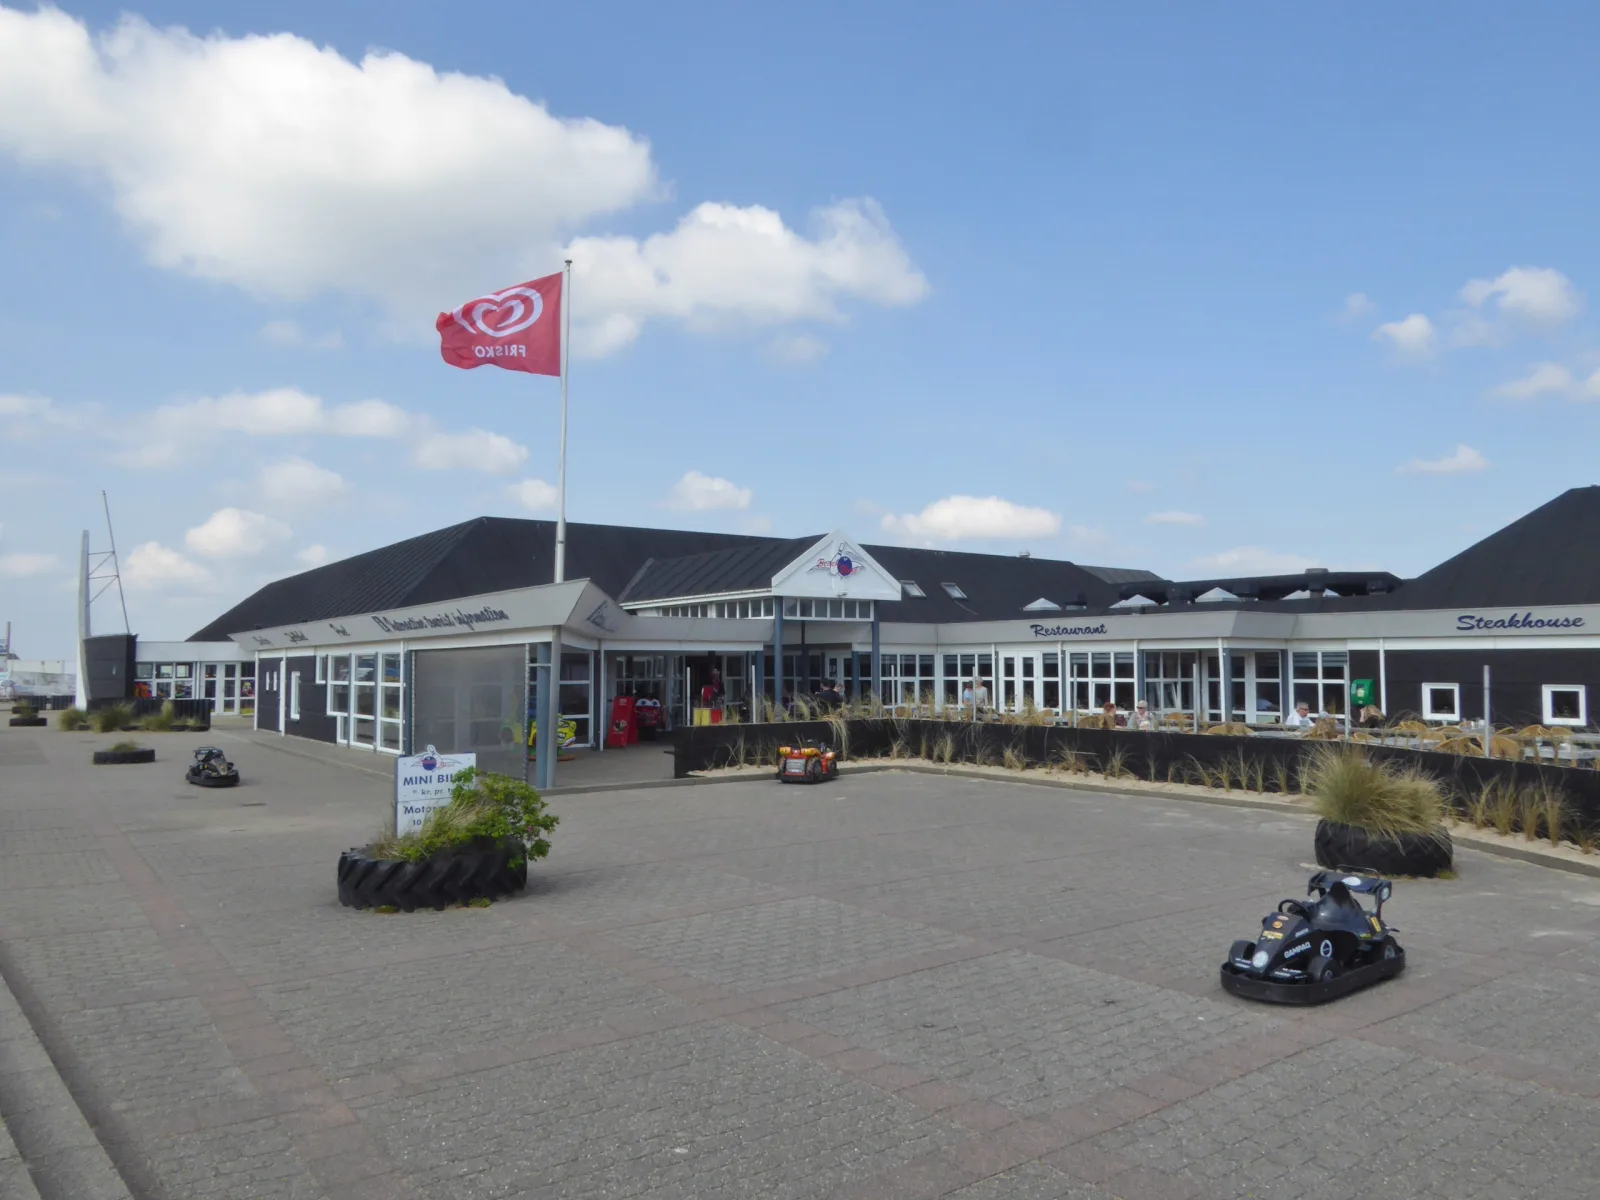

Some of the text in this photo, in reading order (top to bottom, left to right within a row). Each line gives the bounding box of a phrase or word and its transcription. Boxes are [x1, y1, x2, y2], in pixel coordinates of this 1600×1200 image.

[452, 606, 510, 632] information
[1456, 612, 1585, 630] Steakhouse
[1030, 624, 1107, 637] Restaurant
[403, 775, 432, 786] MINI
